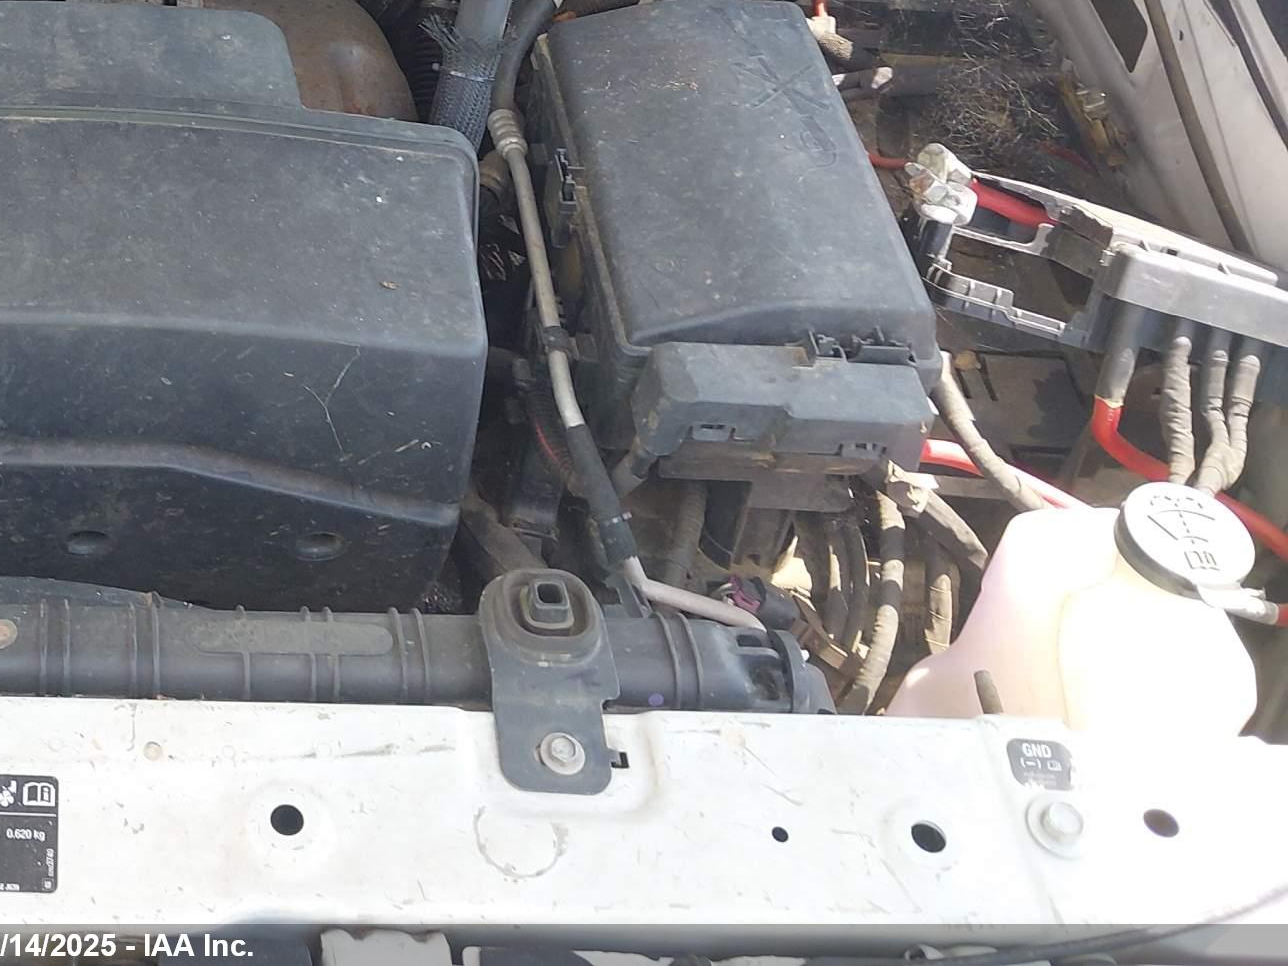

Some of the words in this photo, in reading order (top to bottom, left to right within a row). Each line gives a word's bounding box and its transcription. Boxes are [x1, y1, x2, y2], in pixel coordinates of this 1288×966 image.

[1021, 742, 1052, 758] GND
[6, 827, 32, 840] 0.620
[33, 828, 46, 842] kg
